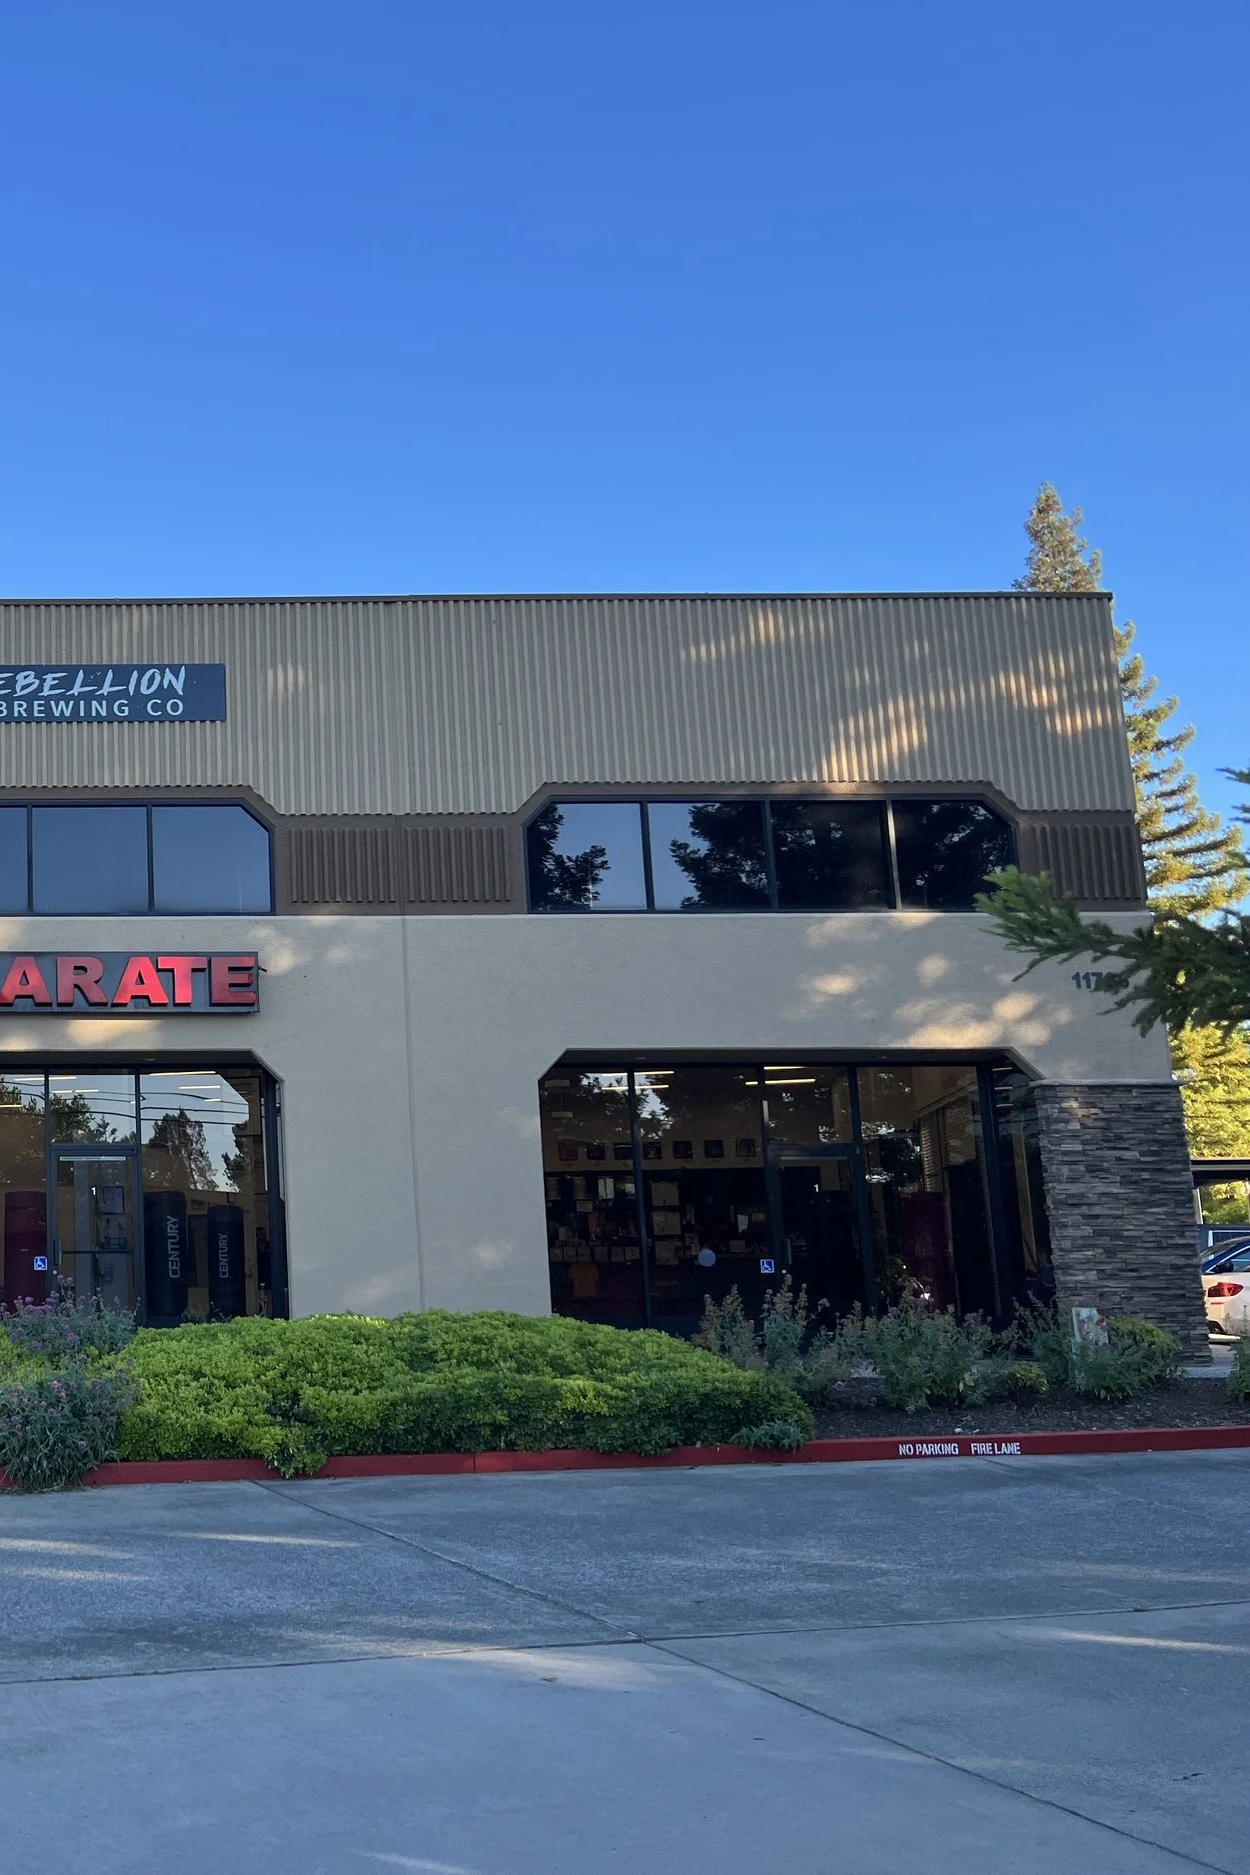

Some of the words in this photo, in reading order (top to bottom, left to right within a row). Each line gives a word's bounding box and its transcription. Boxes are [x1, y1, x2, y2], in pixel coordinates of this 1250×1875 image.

[147, 699, 184, 716] CO
[90, 1186, 96, 1196] 1
[167, 1215, 180, 1278] CENTURY
[218, 1233, 229, 1278] CENTURY
[898, 1444, 914, 1455] NO
[915, 1443, 959, 1455] PARKING
[970, 1442, 993, 1455] FIRE
[994, 1442, 1021, 1454] LANE
